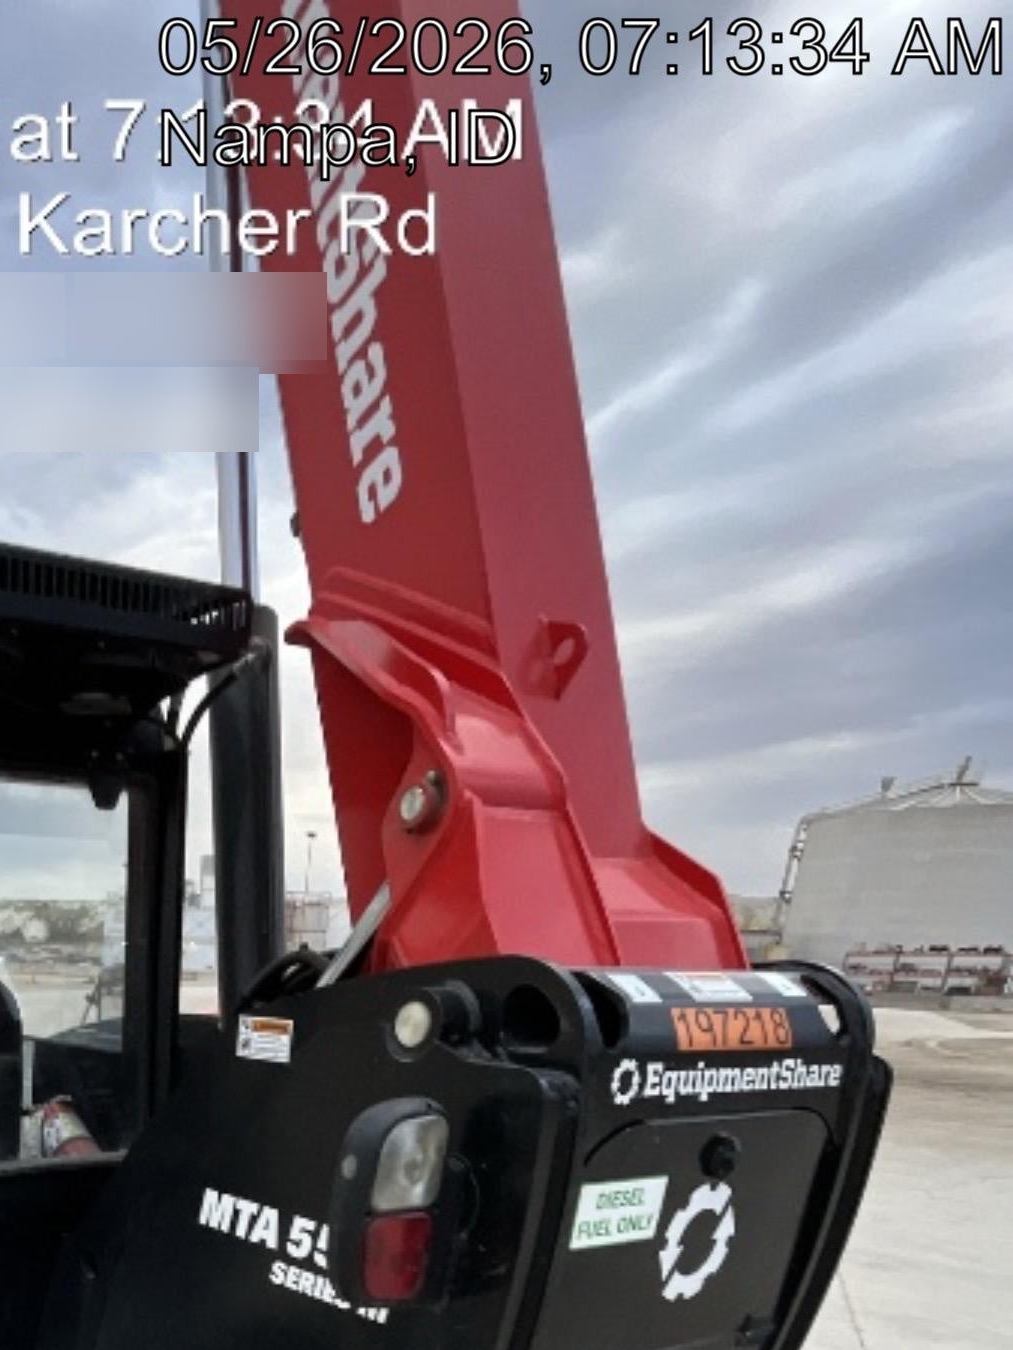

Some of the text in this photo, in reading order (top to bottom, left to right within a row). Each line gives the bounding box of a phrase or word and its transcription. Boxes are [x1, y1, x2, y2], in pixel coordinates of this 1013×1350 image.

[676, 1009, 790, 1049] 197218
[643, 1059, 844, 1104] EquipmentShare
[199, 1187, 280, 1250] MTA
